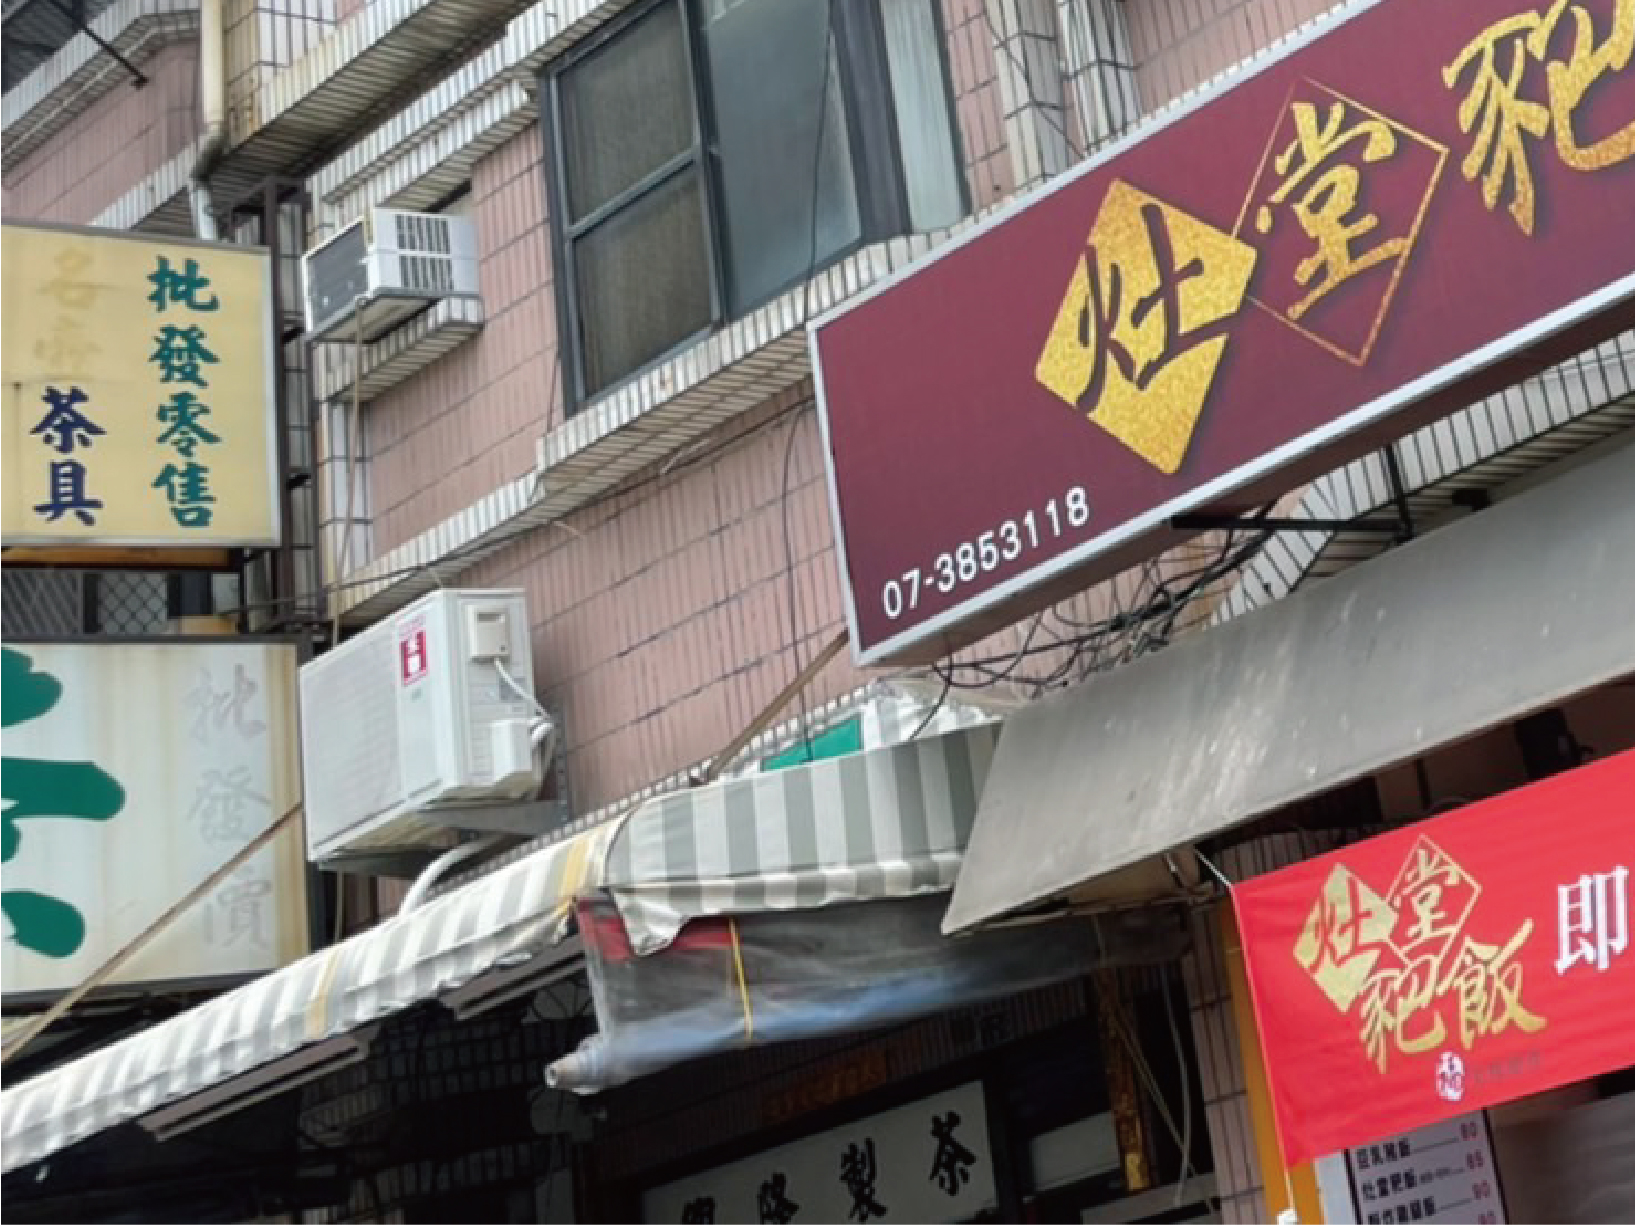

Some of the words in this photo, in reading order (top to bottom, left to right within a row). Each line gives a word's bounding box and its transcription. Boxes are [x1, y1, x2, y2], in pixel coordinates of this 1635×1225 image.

[146, 255, 222, 529] 批發零售
[882, 485, 1089, 620] 07-3853118
